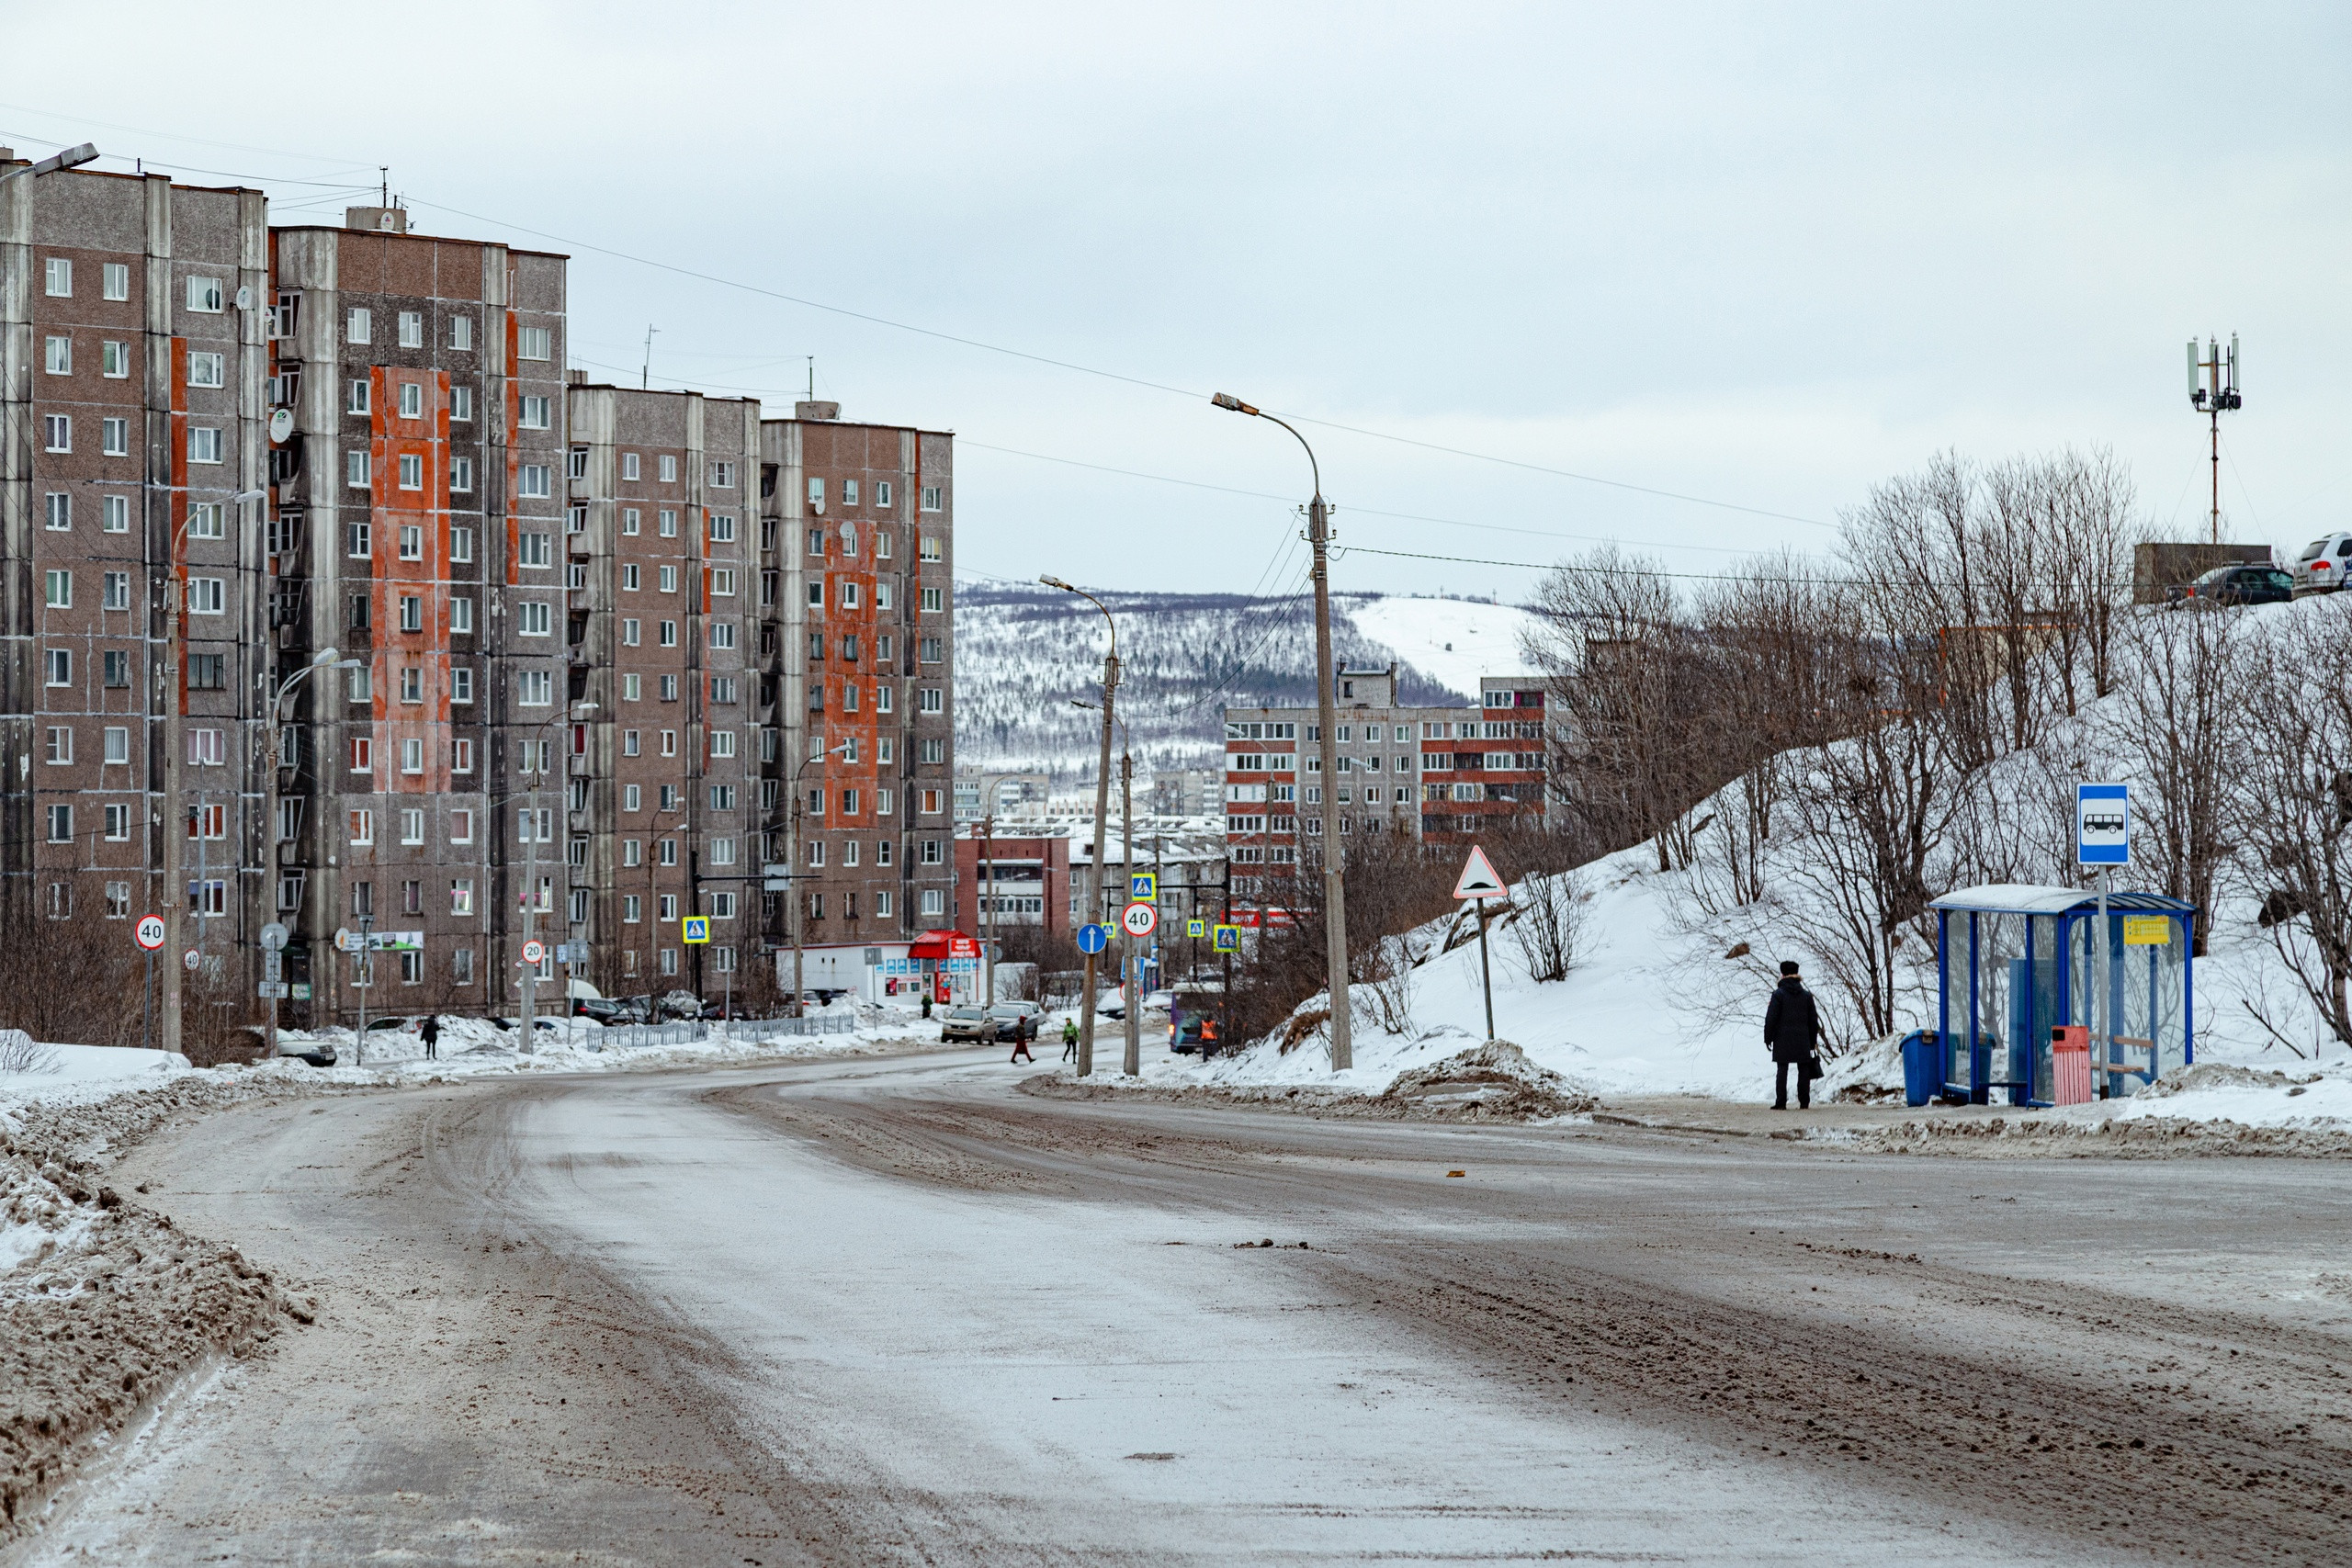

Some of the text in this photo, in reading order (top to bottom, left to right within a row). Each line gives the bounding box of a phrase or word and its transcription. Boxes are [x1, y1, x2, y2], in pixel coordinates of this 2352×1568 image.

[1128, 912, 1149, 926] 40
[141, 924, 162, 939] 40
[526, 946, 539, 956] 20
[187, 954, 198, 965] 40
